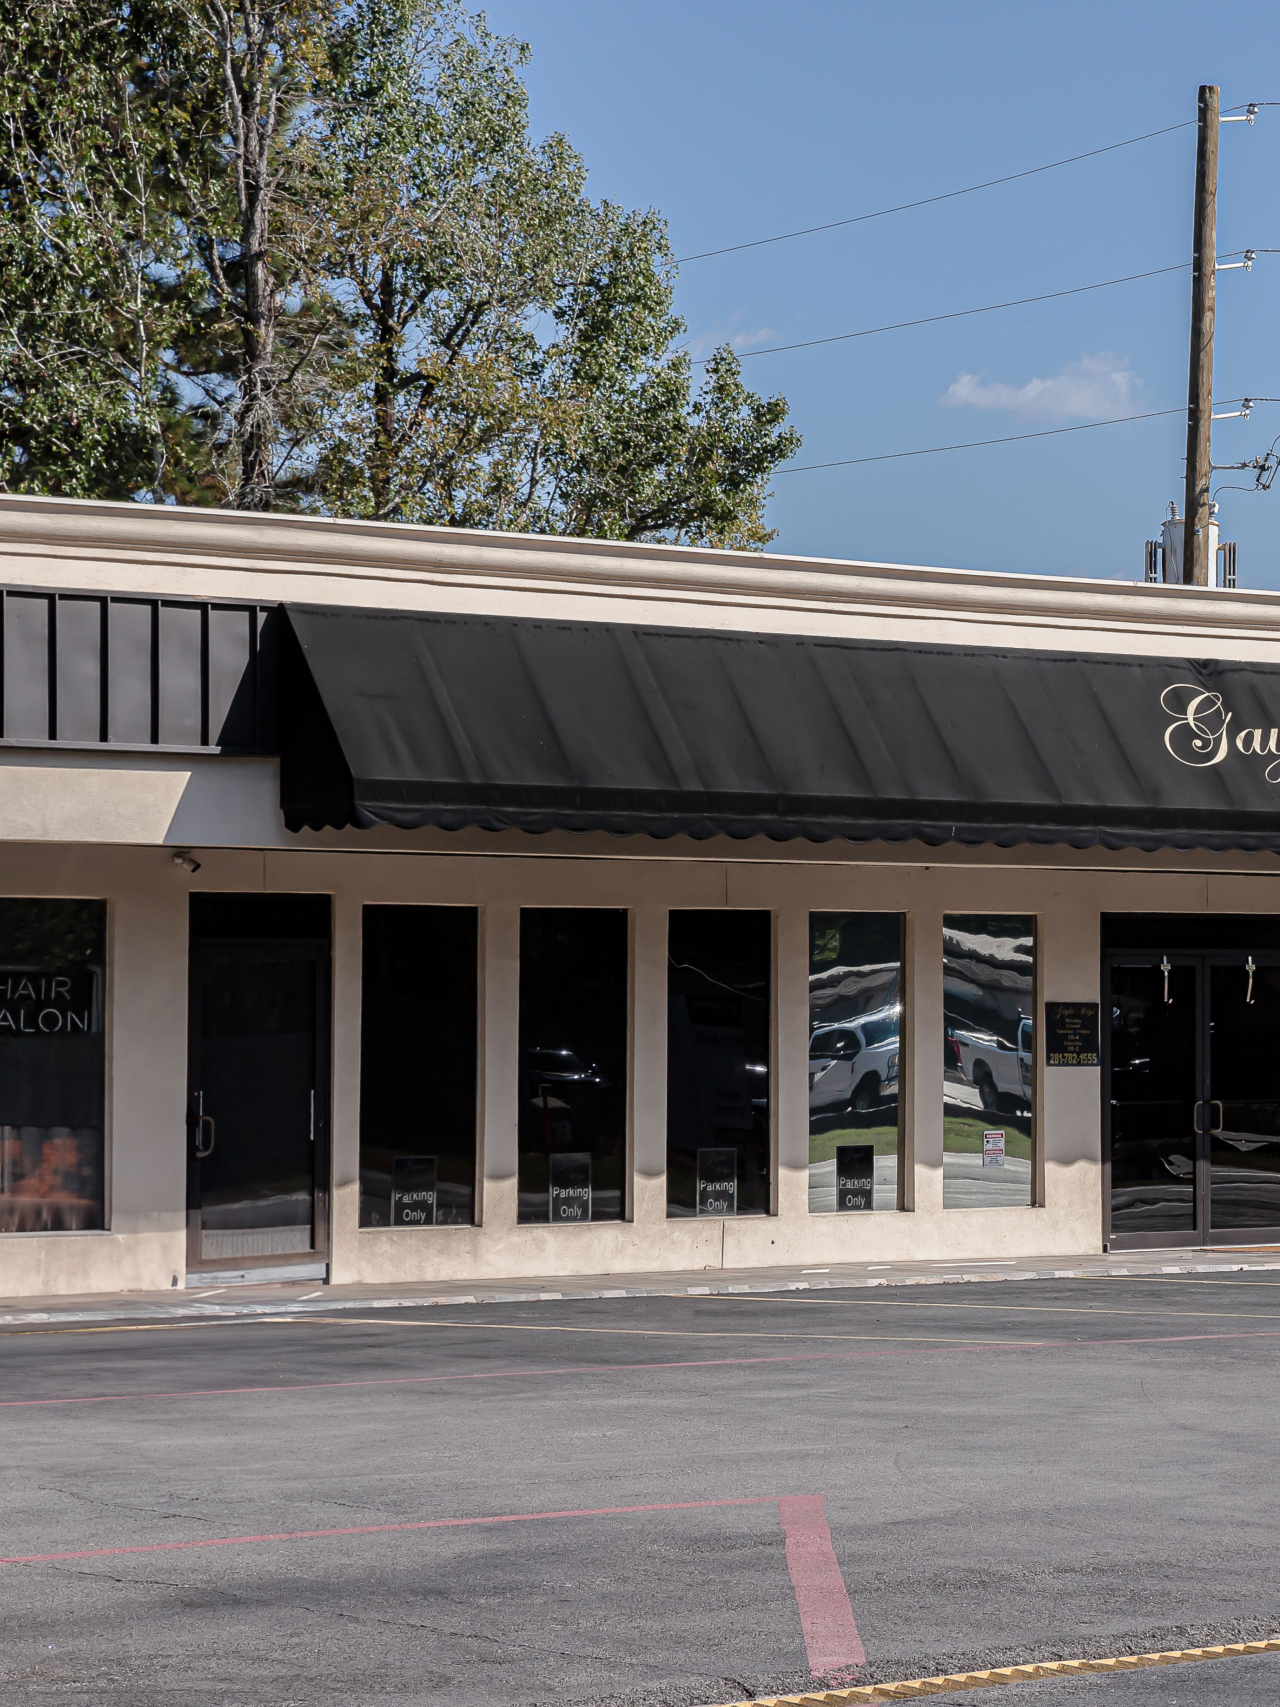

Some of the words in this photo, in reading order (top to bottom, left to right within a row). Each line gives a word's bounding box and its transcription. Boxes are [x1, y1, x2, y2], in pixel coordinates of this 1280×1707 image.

[1050, 1053, 1098, 1064] 281-782-1555
[700, 1180, 734, 1193] Parking
[840, 1176, 871, 1190] Parking
[396, 1190, 434, 1204] Parking
[553, 1186, 588, 1200] Parking
[707, 1198, 728, 1213] Only
[846, 1195, 866, 1208] Only
[402, 1209, 426, 1224] Only
[560, 1206, 582, 1219] Only
